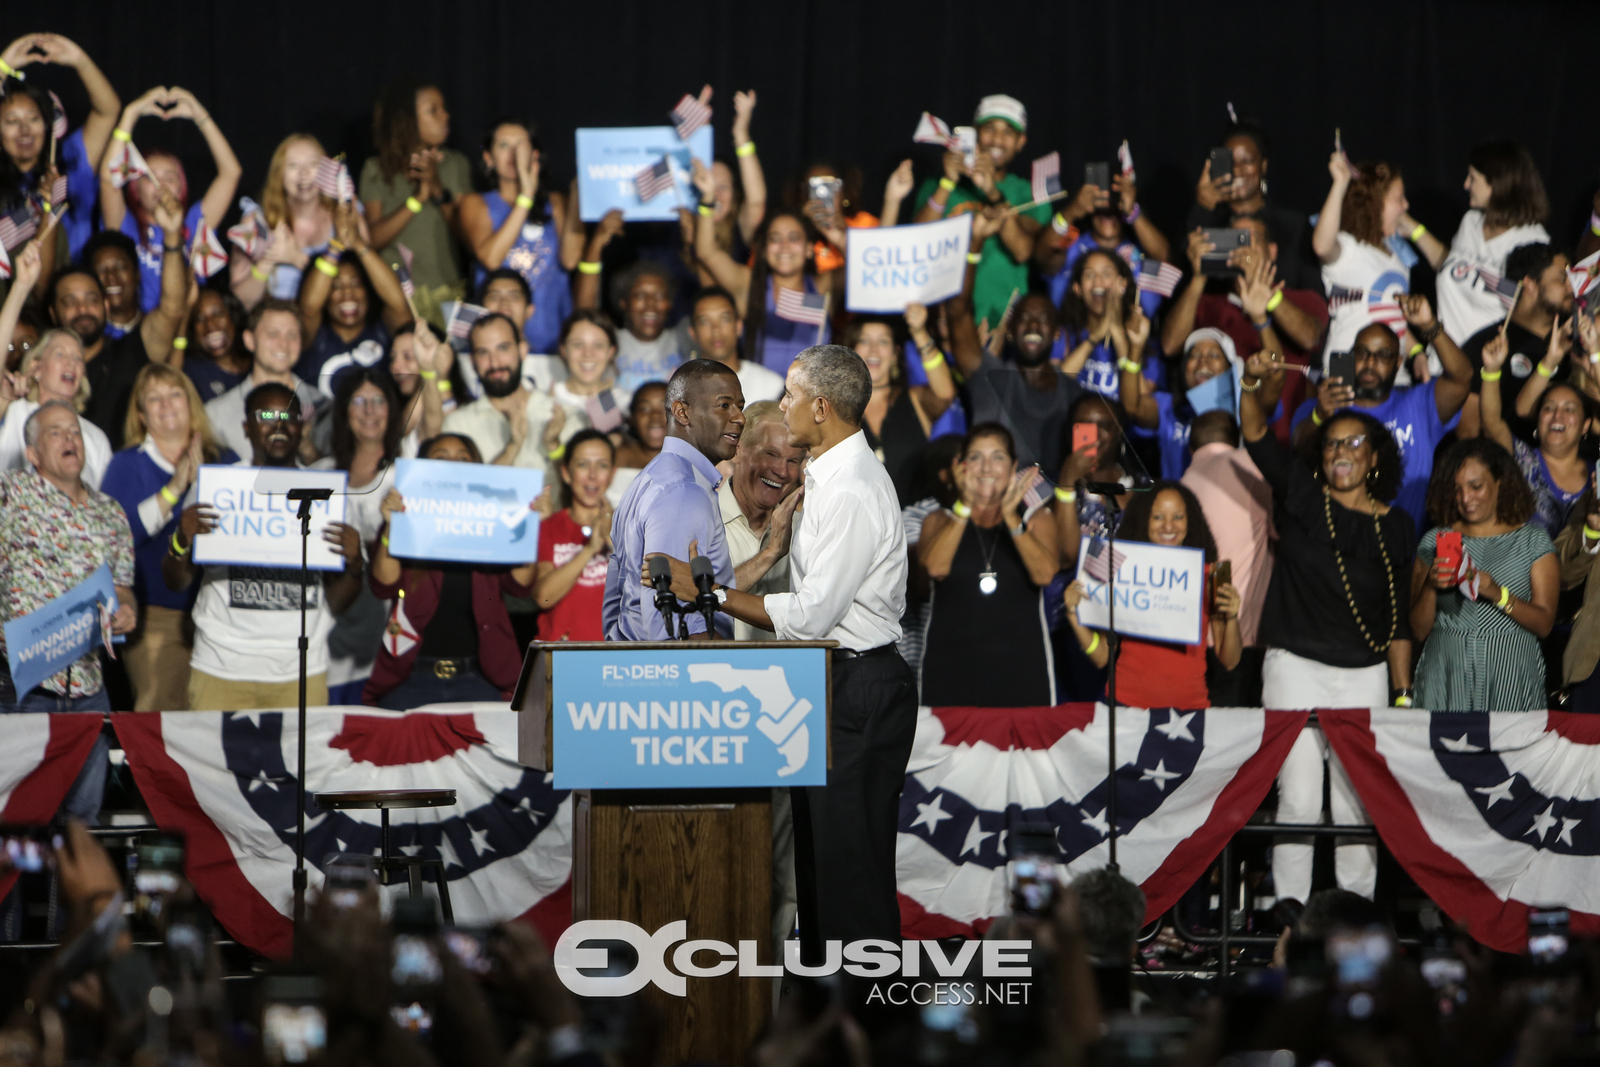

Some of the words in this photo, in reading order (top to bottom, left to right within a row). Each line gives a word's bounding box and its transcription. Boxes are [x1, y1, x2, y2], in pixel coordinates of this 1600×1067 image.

[862, 235, 960, 267] GILLUM
[862, 265, 930, 288] KING
[401, 496, 499, 519] WINNING
[211, 514, 287, 538] KING
[434, 517, 497, 537] TICKET
[1116, 564, 1189, 591] LLUM
[1087, 583, 1151, 611] KING
[18, 613, 94, 663] WINNING
[45, 626, 93, 662] TICKET
[566, 699, 751, 731] WINNING
[630, 735, 750, 766] TICKET
